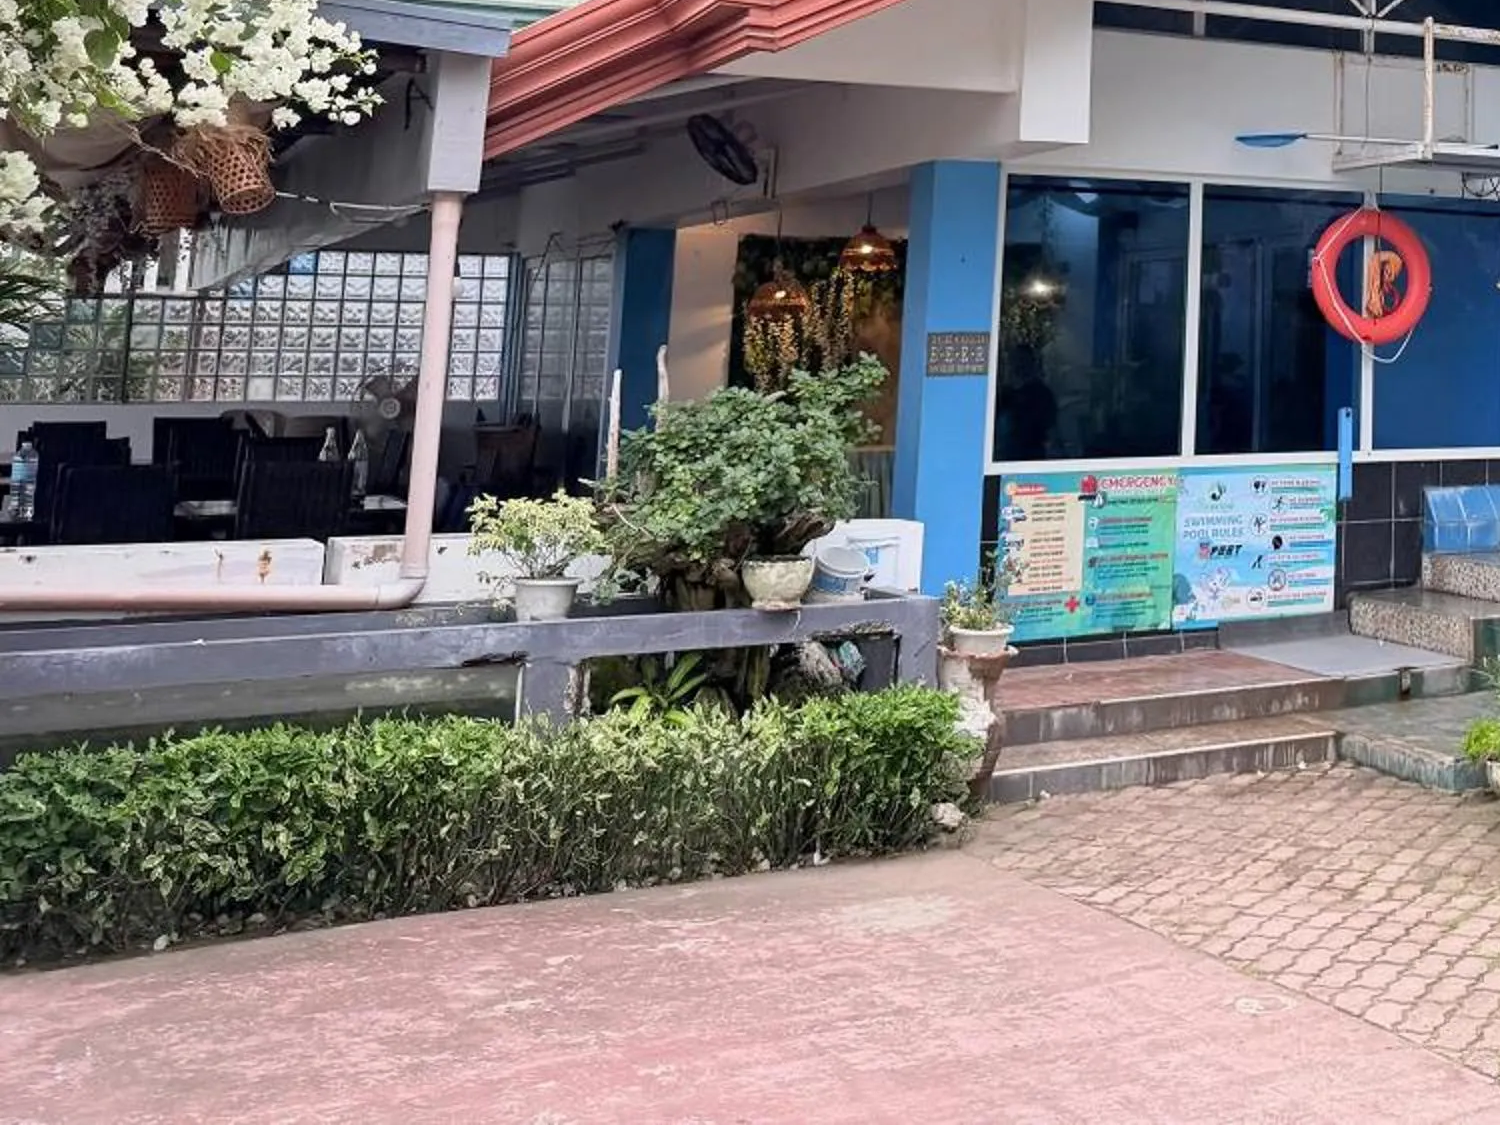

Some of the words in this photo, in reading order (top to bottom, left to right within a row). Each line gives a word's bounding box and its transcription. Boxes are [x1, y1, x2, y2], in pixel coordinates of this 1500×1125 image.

[1184, 513, 1244, 528] SWIMMING
[1183, 528, 1209, 540] POOL
[1211, 527, 1244, 538] RULES
[1210, 544, 1243, 557] FEET
